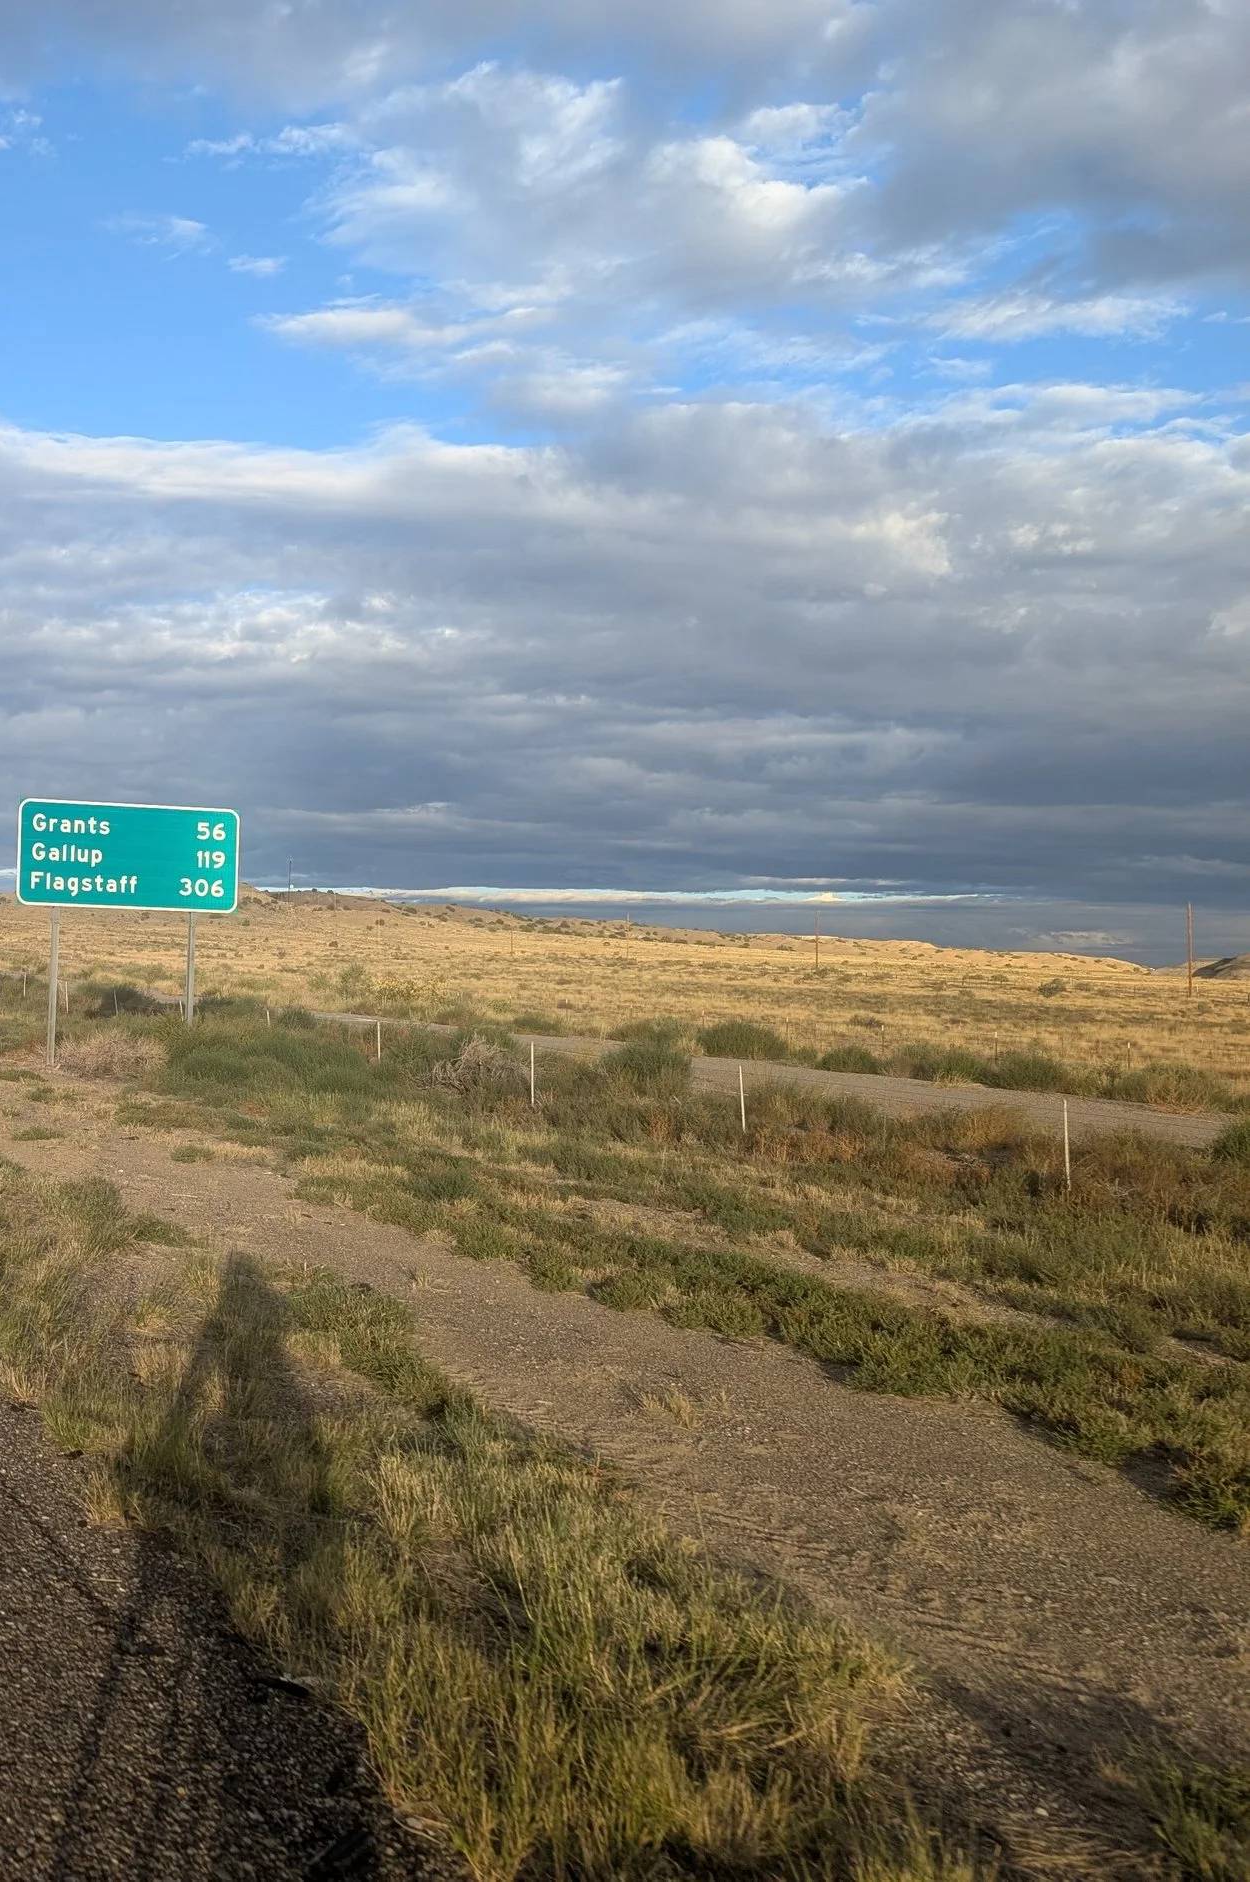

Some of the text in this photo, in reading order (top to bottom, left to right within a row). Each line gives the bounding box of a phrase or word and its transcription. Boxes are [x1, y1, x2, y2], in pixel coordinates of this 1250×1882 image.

[32, 813, 226, 841] Grants 56
[31, 842, 226, 869] Gallup 119
[30, 871, 225, 898] Flagstaff 306
